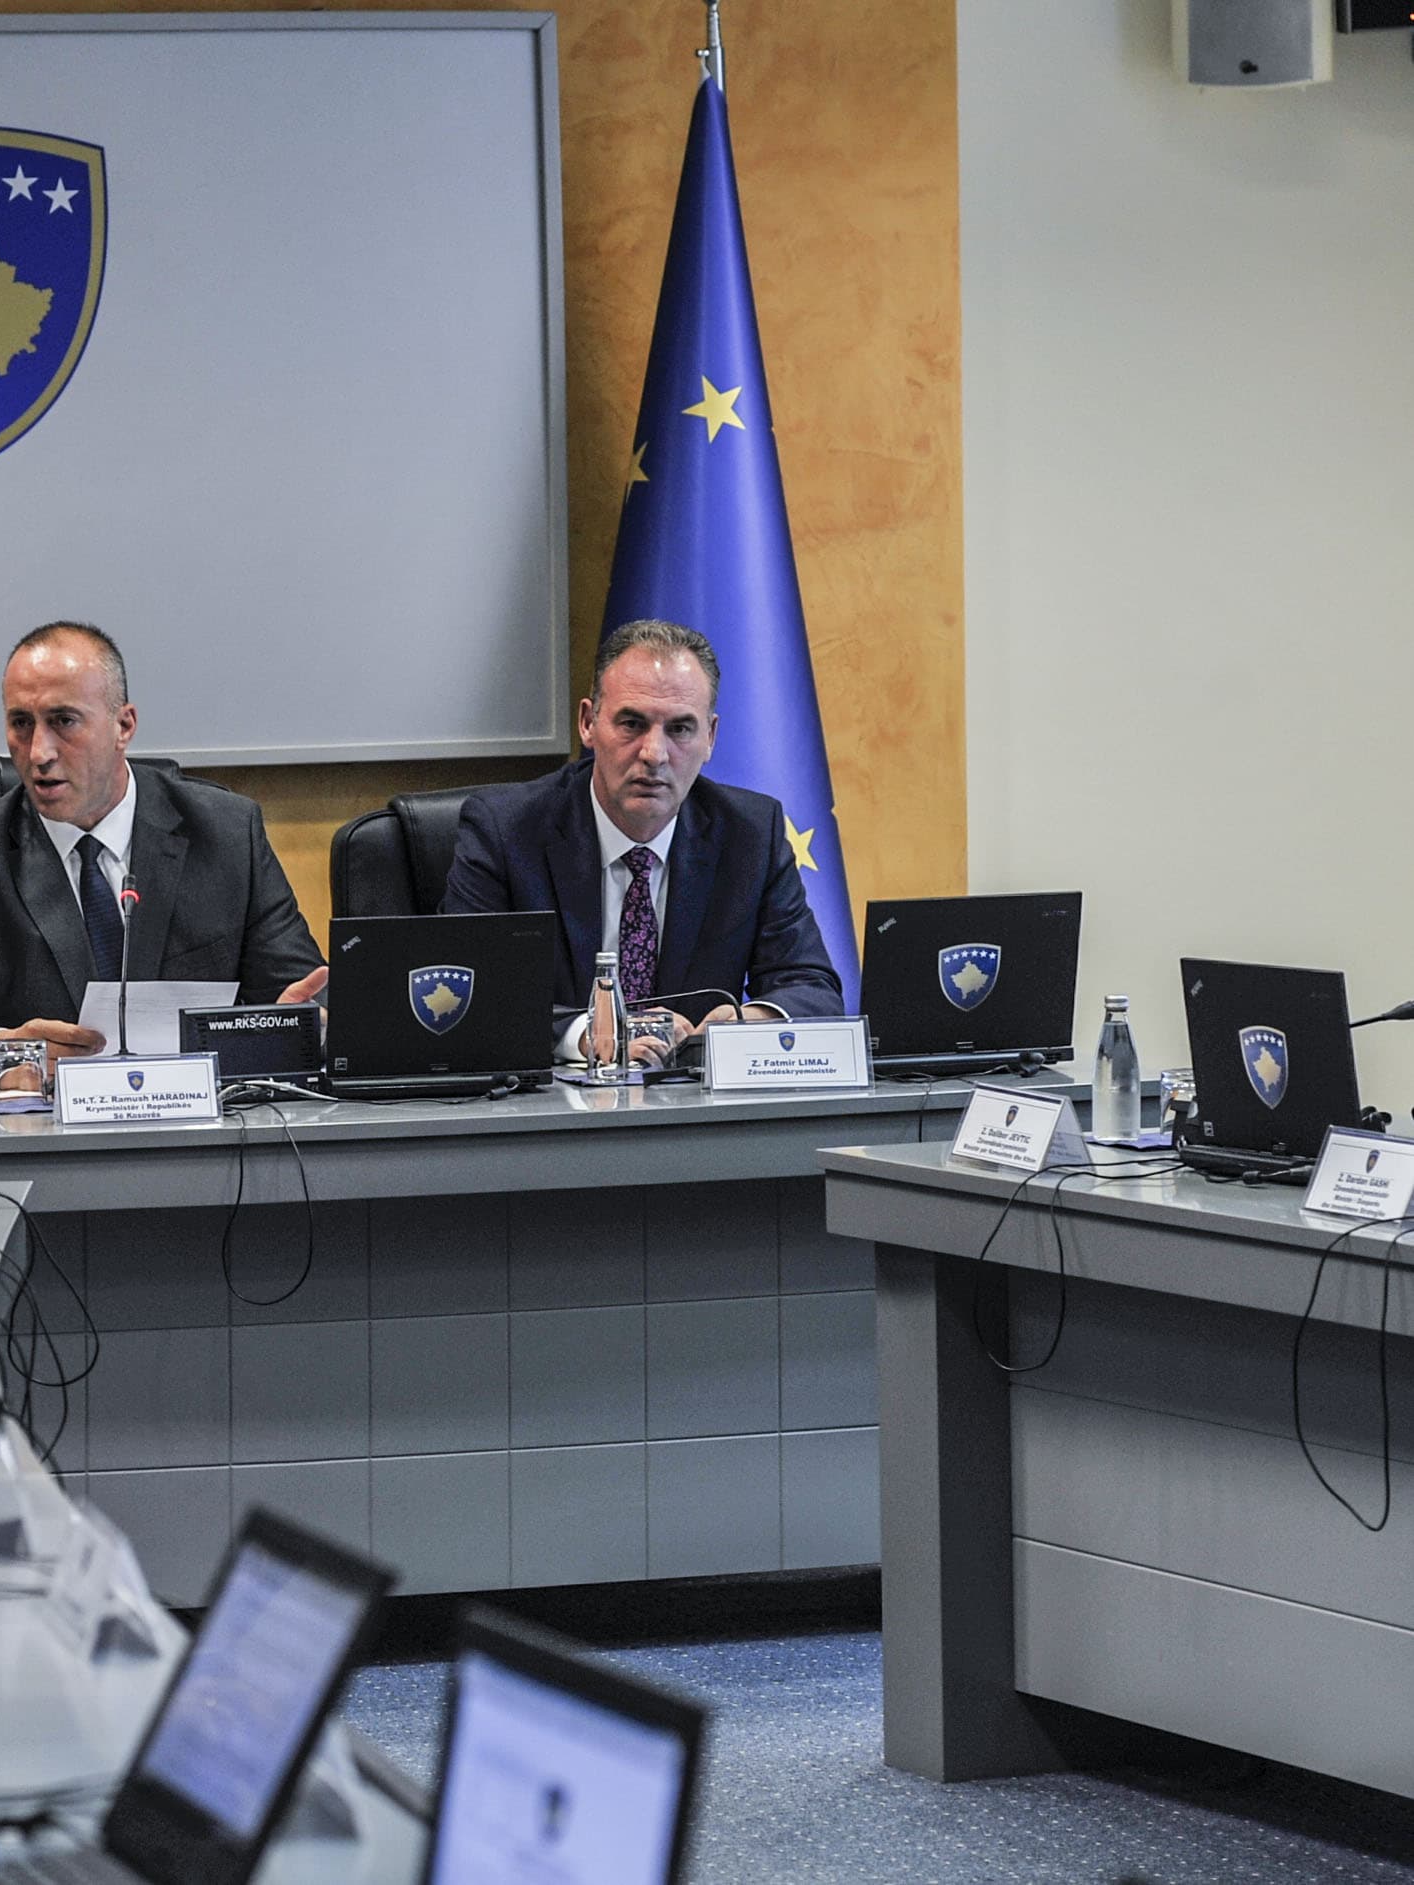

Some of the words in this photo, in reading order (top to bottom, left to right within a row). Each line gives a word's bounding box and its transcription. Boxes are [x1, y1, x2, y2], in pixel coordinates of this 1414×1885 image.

[208, 1016, 299, 1030] www.RKS-GOV.net
[764, 1059, 796, 1067] Fatmir
[798, 1058, 829, 1066] LIMAJ
[111, 1095, 149, 1103] Ramush
[151, 1092, 208, 1101] HARADINAJ
